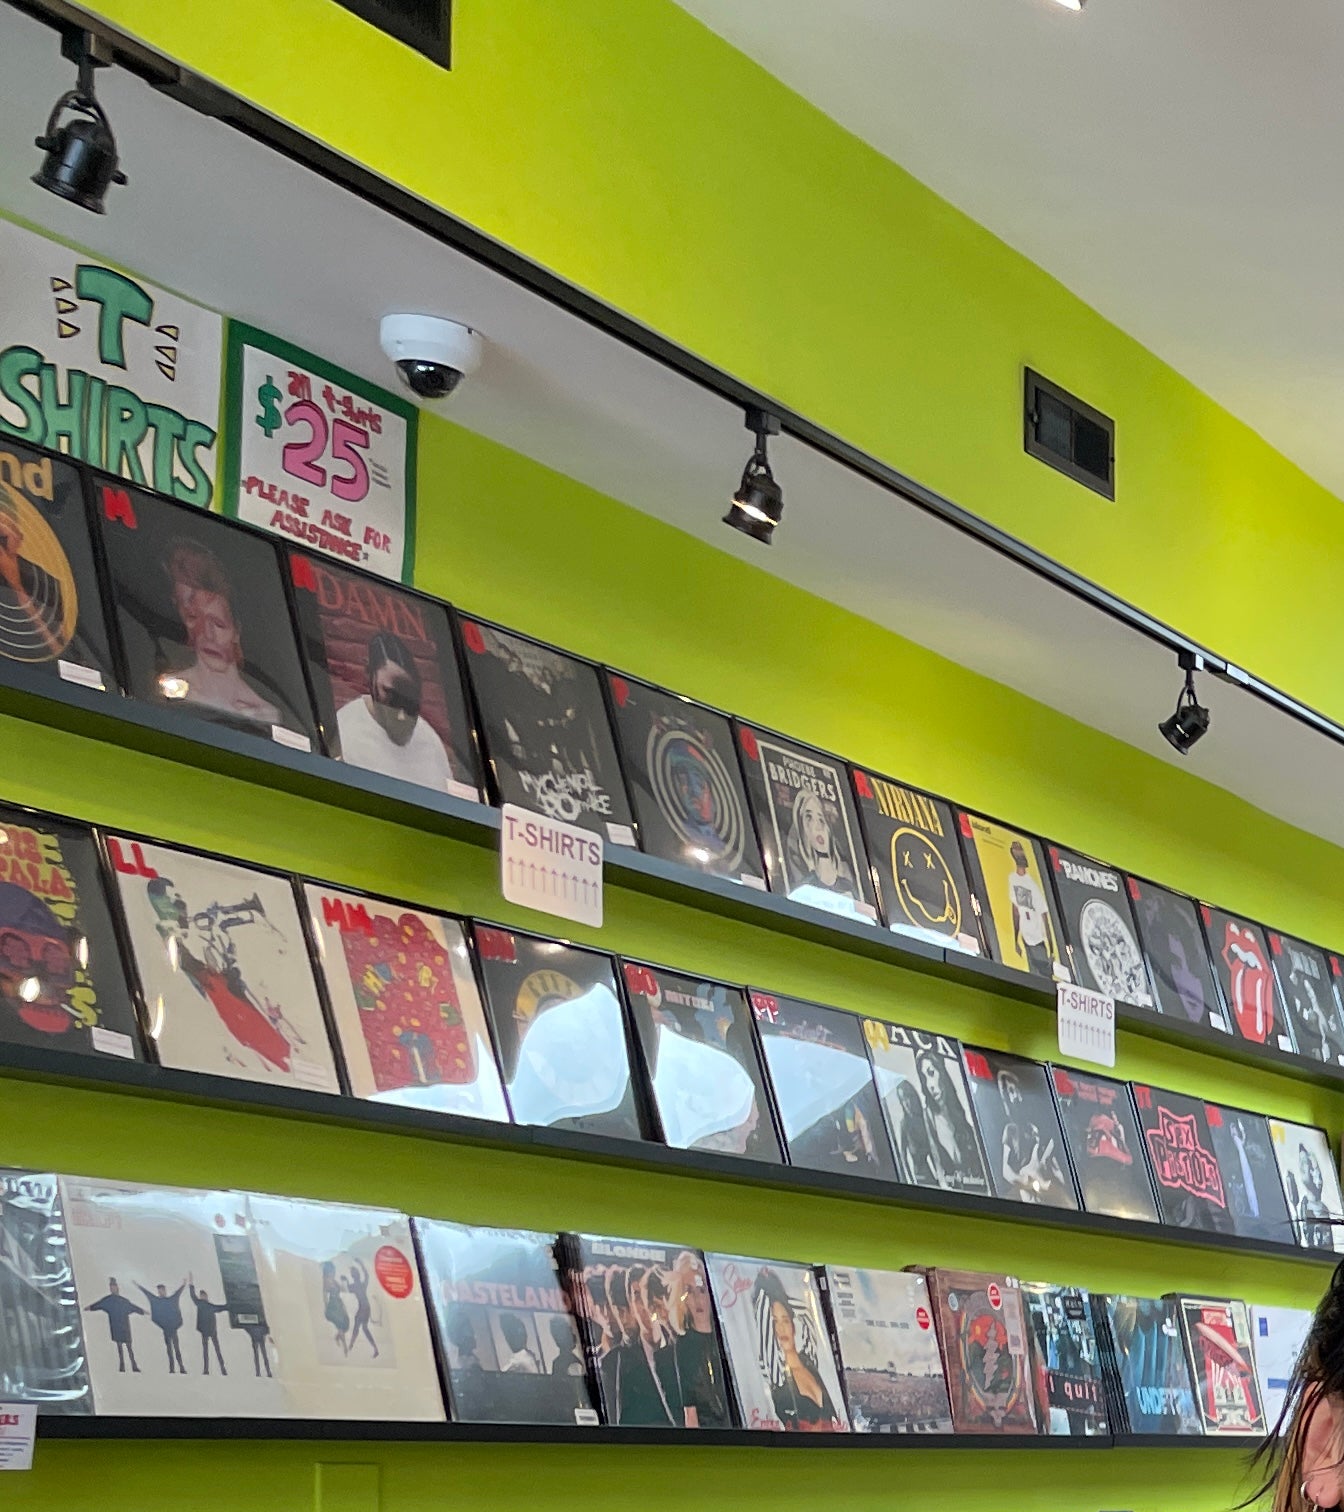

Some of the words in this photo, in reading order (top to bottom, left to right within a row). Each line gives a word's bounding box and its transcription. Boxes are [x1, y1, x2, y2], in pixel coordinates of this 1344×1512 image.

[76, 264, 153, 369] T
[0, 345, 217, 508] SHIRTS
[321, 510, 352, 537] ASK
[363, 526, 391, 553] FOR
[768, 761, 836, 803] BRIDGERS
[869, 776, 945, 838] NIRVANA
[505, 815, 600, 866] T-SHIRTS
[1059, 858, 1120, 893] RAMONES
[1058, 986, 1114, 1020] T-SHIRTS
